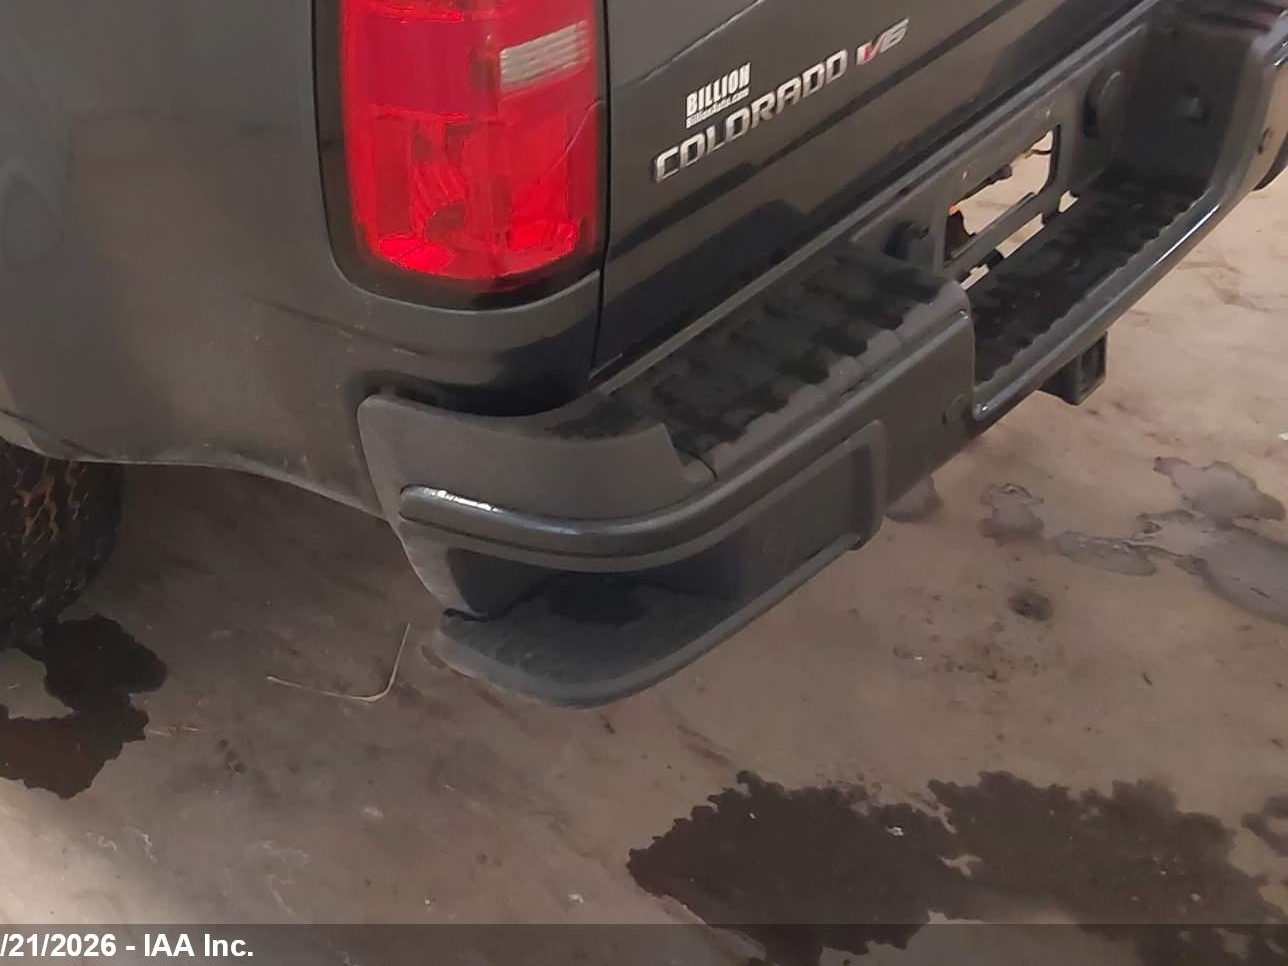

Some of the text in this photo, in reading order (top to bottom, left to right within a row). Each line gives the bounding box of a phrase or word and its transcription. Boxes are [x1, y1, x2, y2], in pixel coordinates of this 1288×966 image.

[652, 49, 848, 183] COLORADO
[856, 17, 910, 66] V6
[686, 61, 751, 118] BILLION
